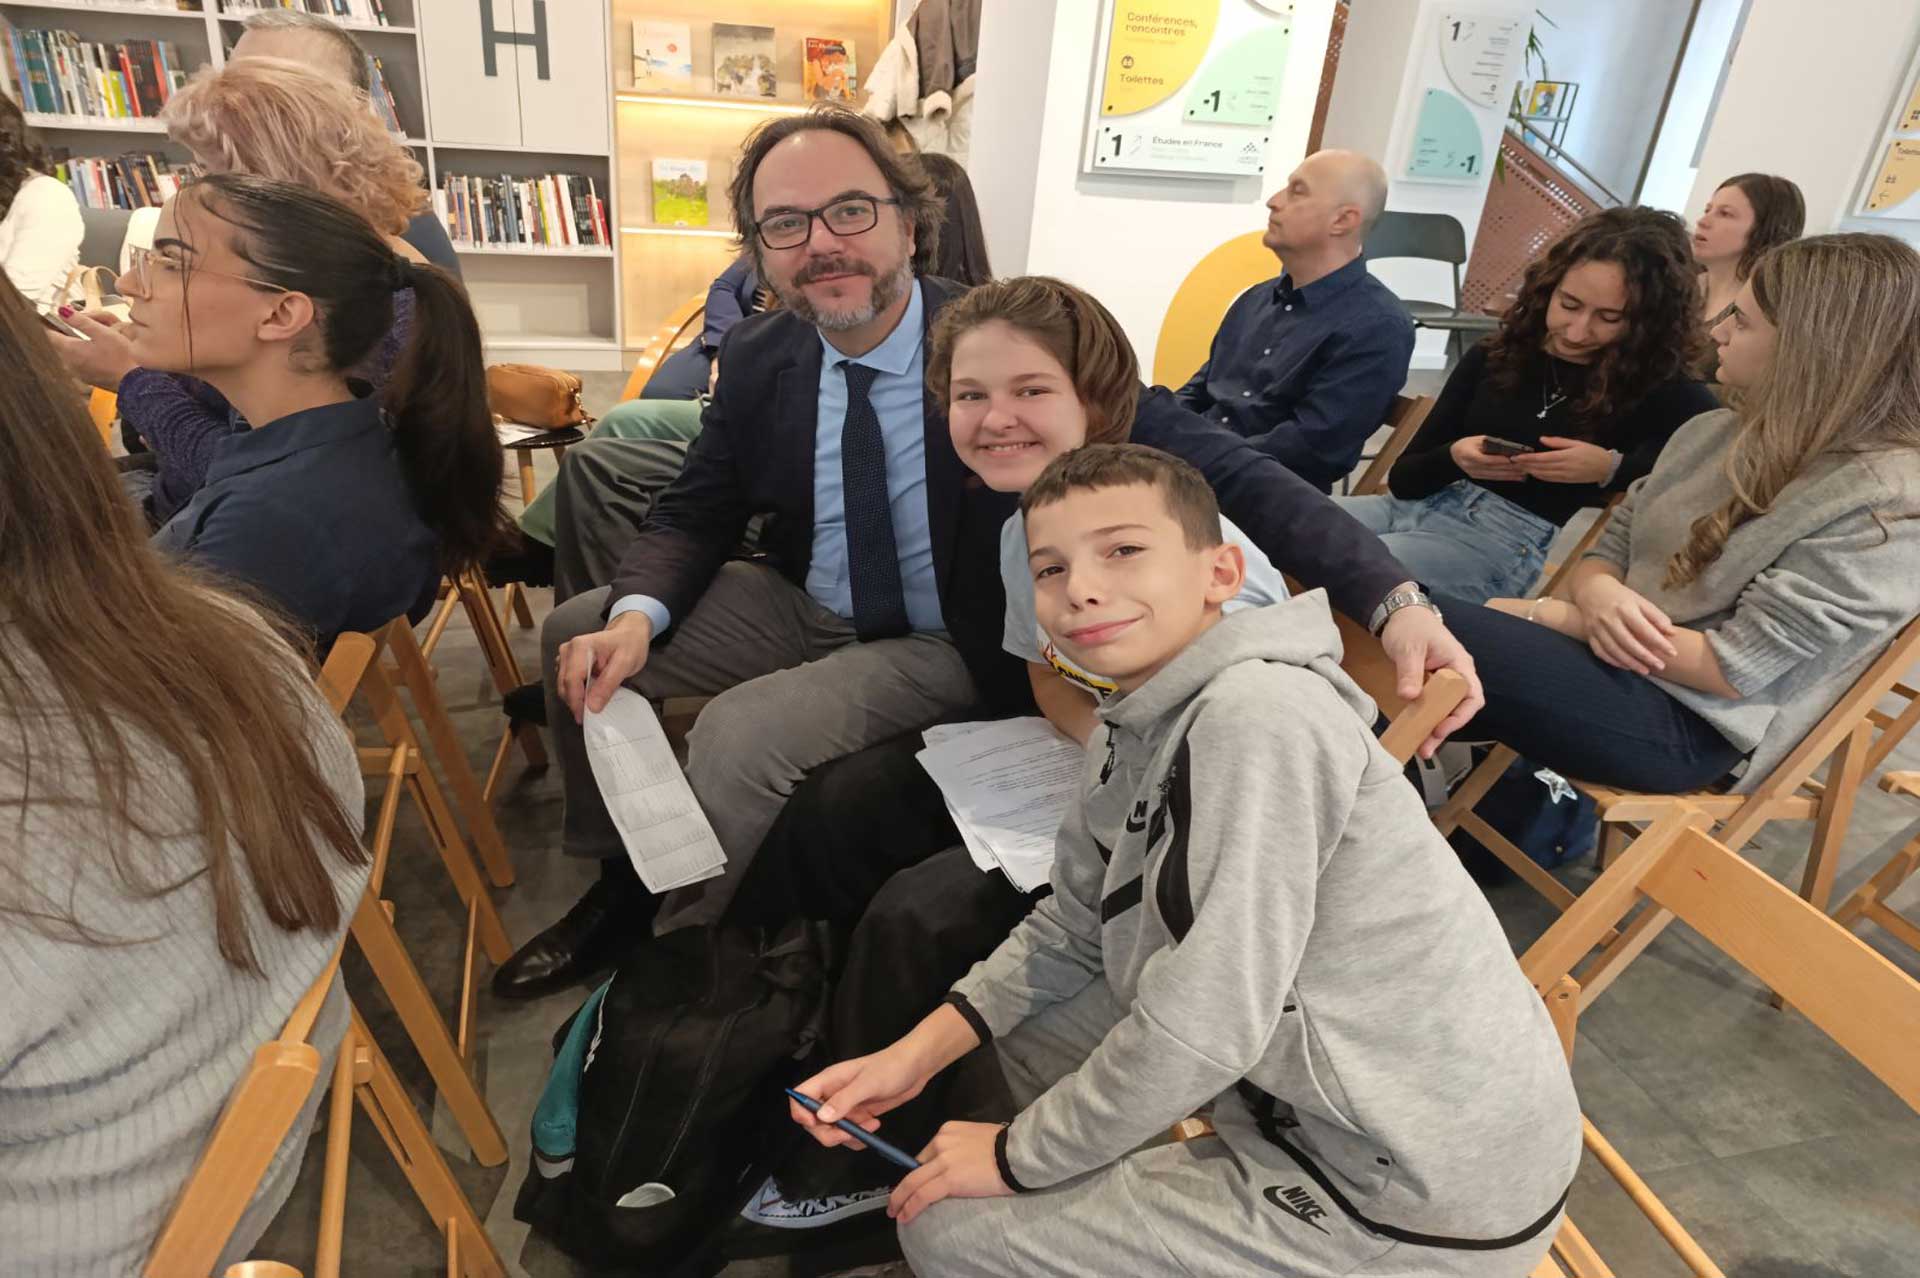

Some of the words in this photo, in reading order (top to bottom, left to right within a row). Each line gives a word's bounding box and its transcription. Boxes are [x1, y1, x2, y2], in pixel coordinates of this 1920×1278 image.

[479, 0, 550, 80] H
[1125, 24, 1186, 37] rencontres
[1451, 20, 1462, 41] 1
[1119, 73, 1164, 86] Toilettes
[1111, 134, 1123, 157] 1
[1193, 138, 1224, 149] France
[1281, 1185, 1328, 1220] NIKE
